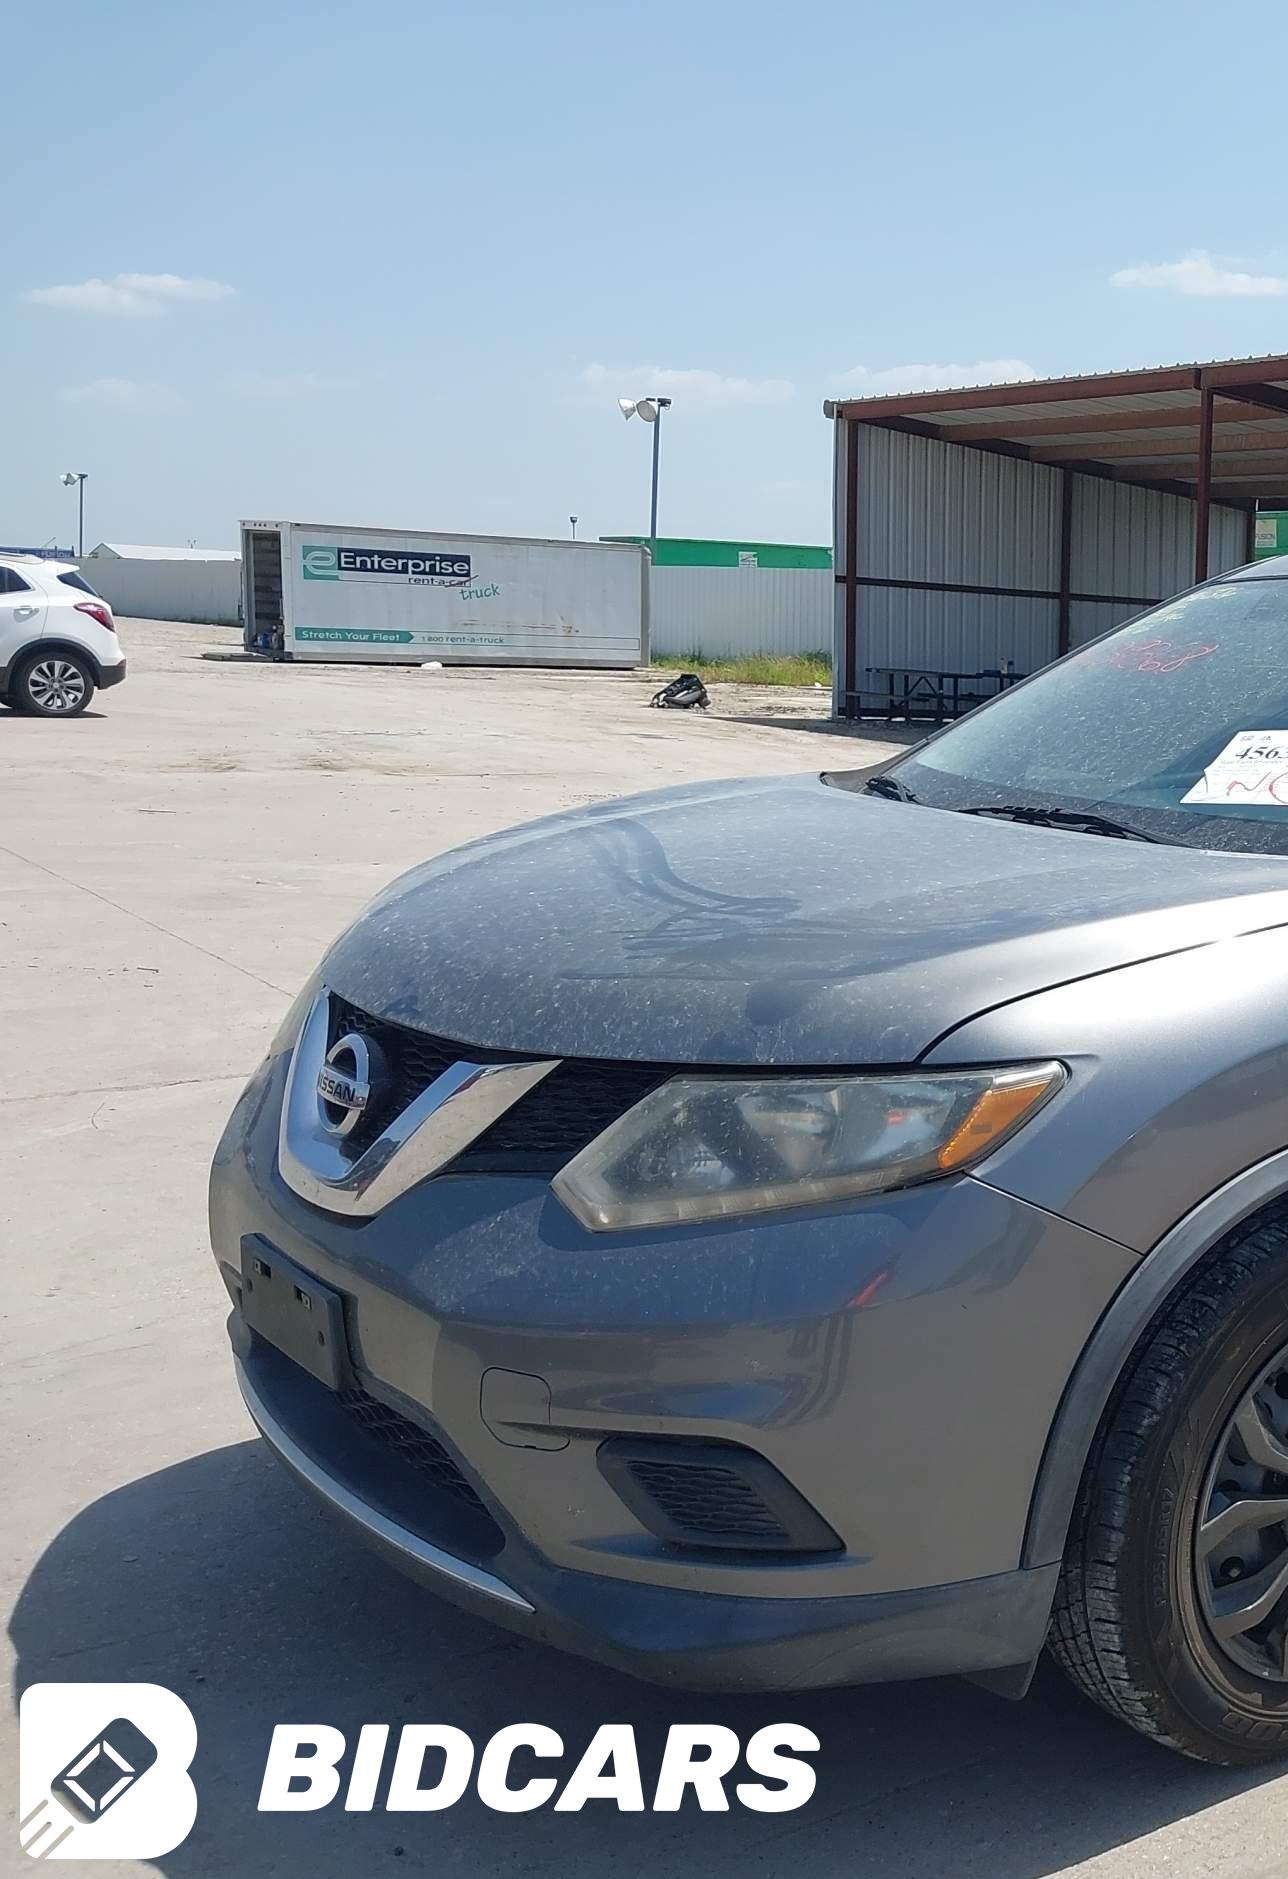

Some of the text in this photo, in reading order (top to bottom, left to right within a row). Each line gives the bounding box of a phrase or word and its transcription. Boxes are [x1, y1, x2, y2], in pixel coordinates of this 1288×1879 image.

[340, 551, 469, 575] Enterprise
[459, 583, 501, 601] truck
[302, 630, 400, 642] Stretch Your Fleet
[446, 635, 505, 644] rent-a-truck
